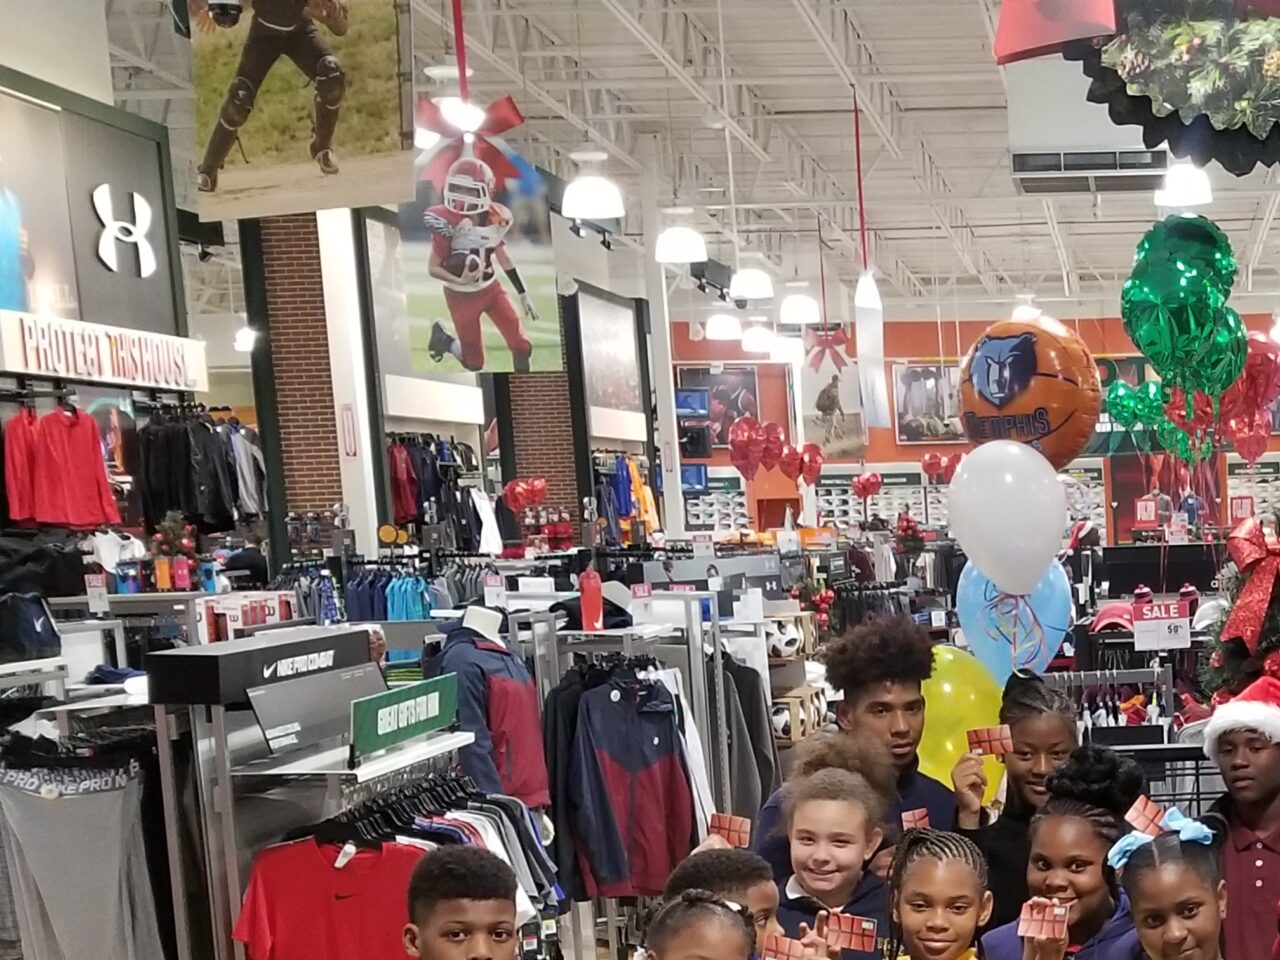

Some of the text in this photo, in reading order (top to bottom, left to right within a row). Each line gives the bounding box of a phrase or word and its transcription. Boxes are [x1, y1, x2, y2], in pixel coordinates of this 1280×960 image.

[20, 318, 105, 377] PROTECT
[105, 331, 139, 381] THIS
[964, 407, 1050, 441] MEMPHIS
[1142, 604, 1179, 619] SALE
[277, 657, 294, 678] NIKE
[377, 704, 398, 735] GREAT
[4, 771, 39, 790] PRO
[79, 776, 112, 792] PRO
